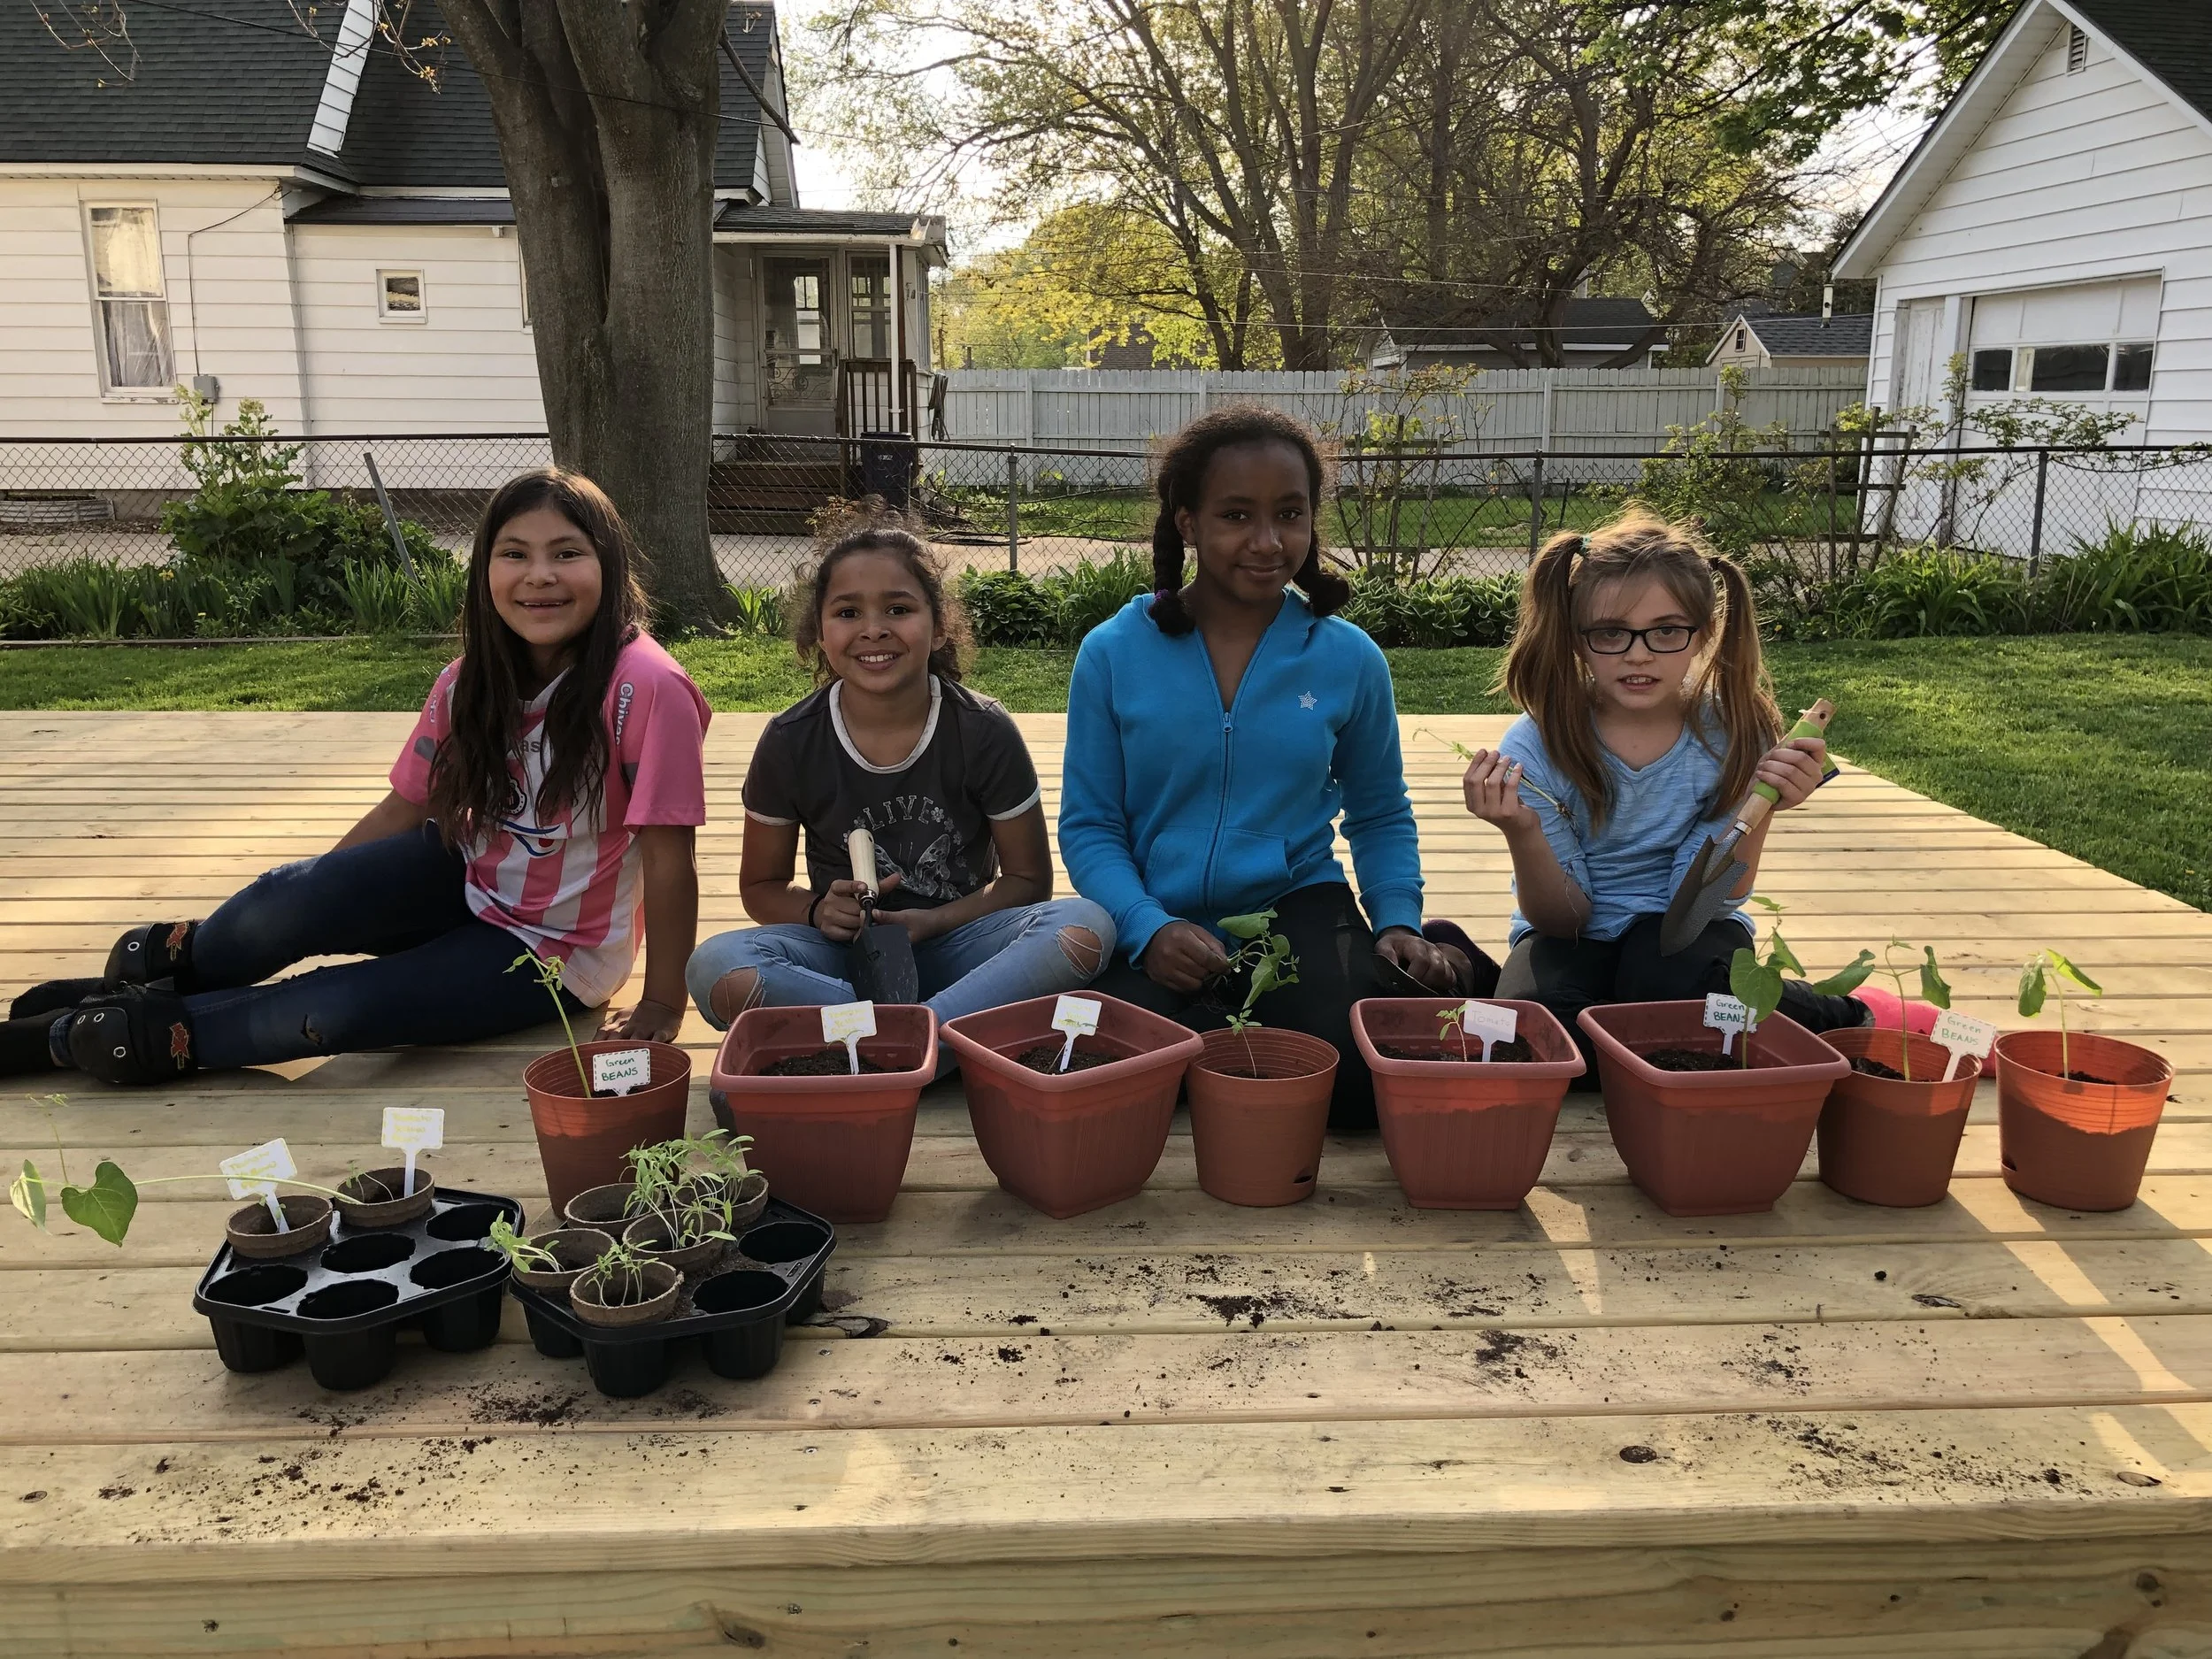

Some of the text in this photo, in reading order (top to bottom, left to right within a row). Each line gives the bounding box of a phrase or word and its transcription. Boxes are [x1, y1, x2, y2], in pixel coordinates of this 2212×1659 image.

[863, 795, 934, 832] LIVE
[1716, 998, 1746, 1011] Green
[1471, 1010, 1511, 1027] Tomato
[1713, 1010, 1747, 1024] BEANS
[1947, 1016, 1982, 1034] Green
[1940, 1027, 1979, 1046] BEANS
[605, 1056, 635, 1067] Green
[601, 1066, 639, 1082] BEANS
